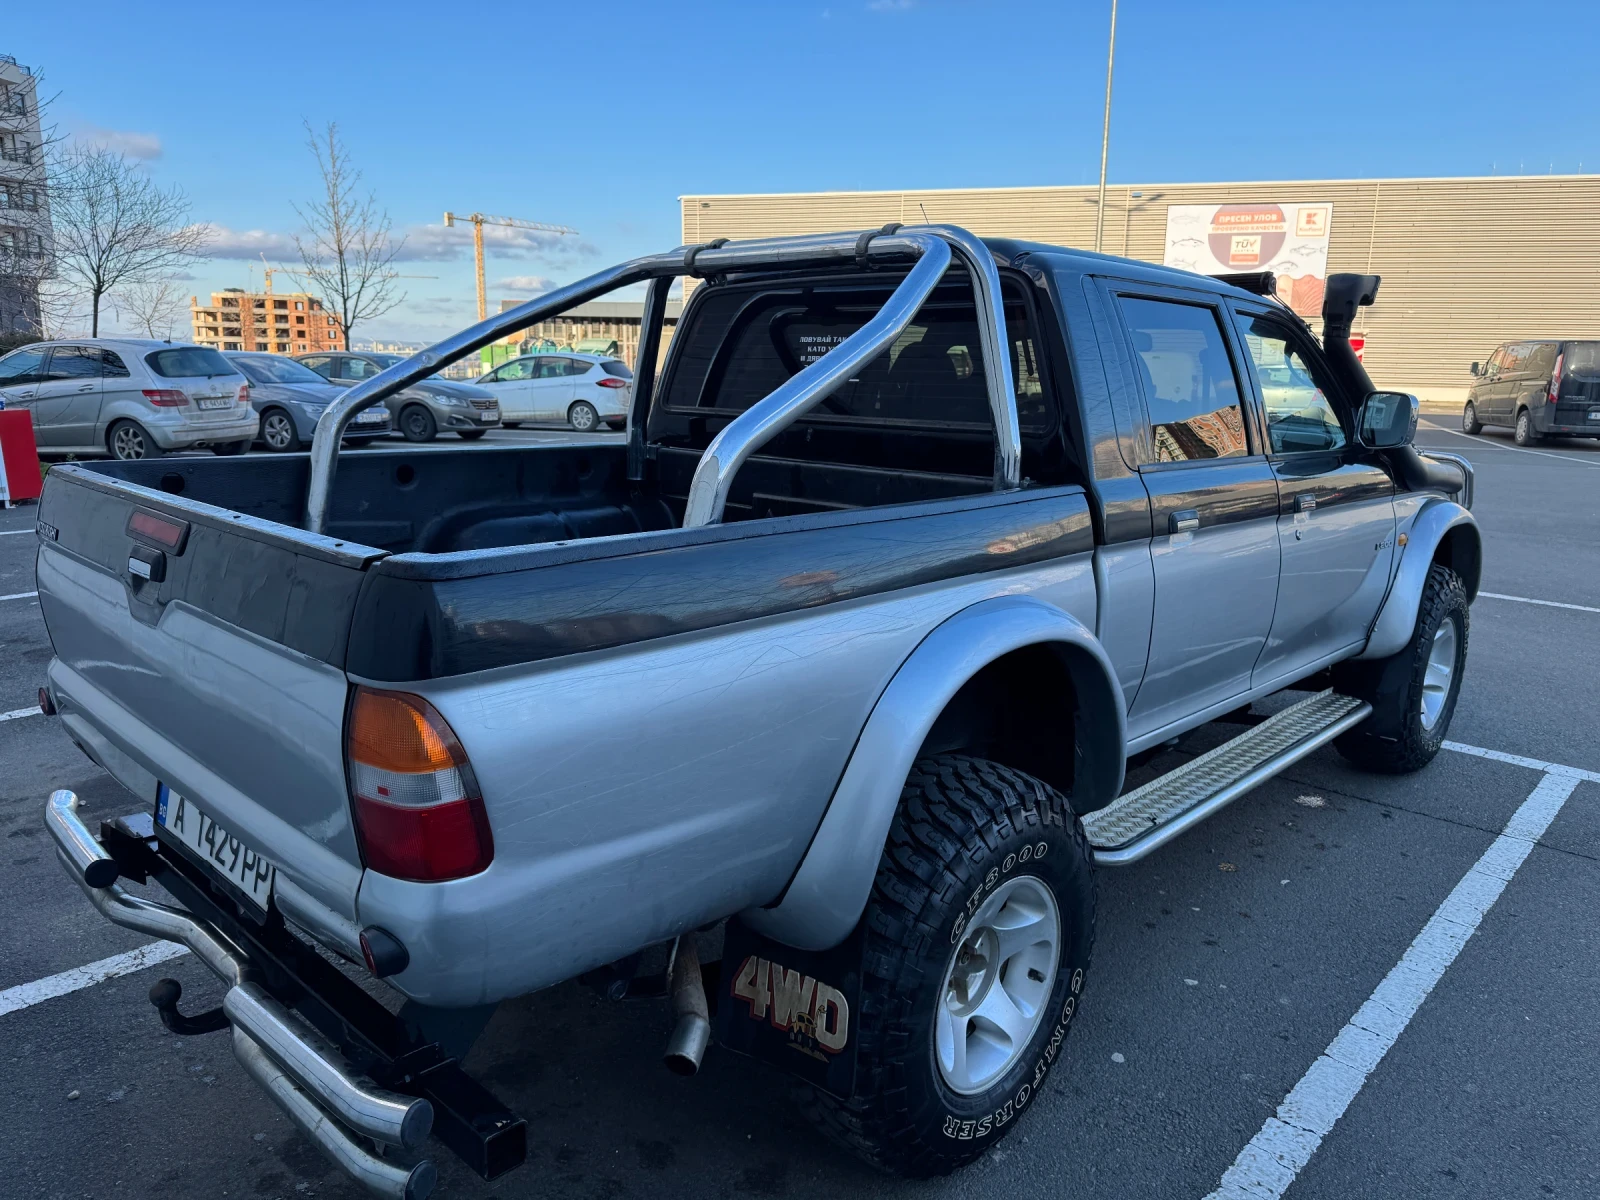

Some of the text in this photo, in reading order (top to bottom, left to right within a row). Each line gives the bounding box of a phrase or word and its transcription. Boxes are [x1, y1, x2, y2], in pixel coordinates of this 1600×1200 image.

[1219, 213, 1277, 223] ПРЕСЕН УЛОВ
[799, 335, 832, 343] ЛОВУВАЙ
[174, 796, 185, 834] A
[950, 841, 1048, 944] CF3000
[731, 955, 849, 1053] 4WD
[943, 968, 1083, 1140] COMFORSER
